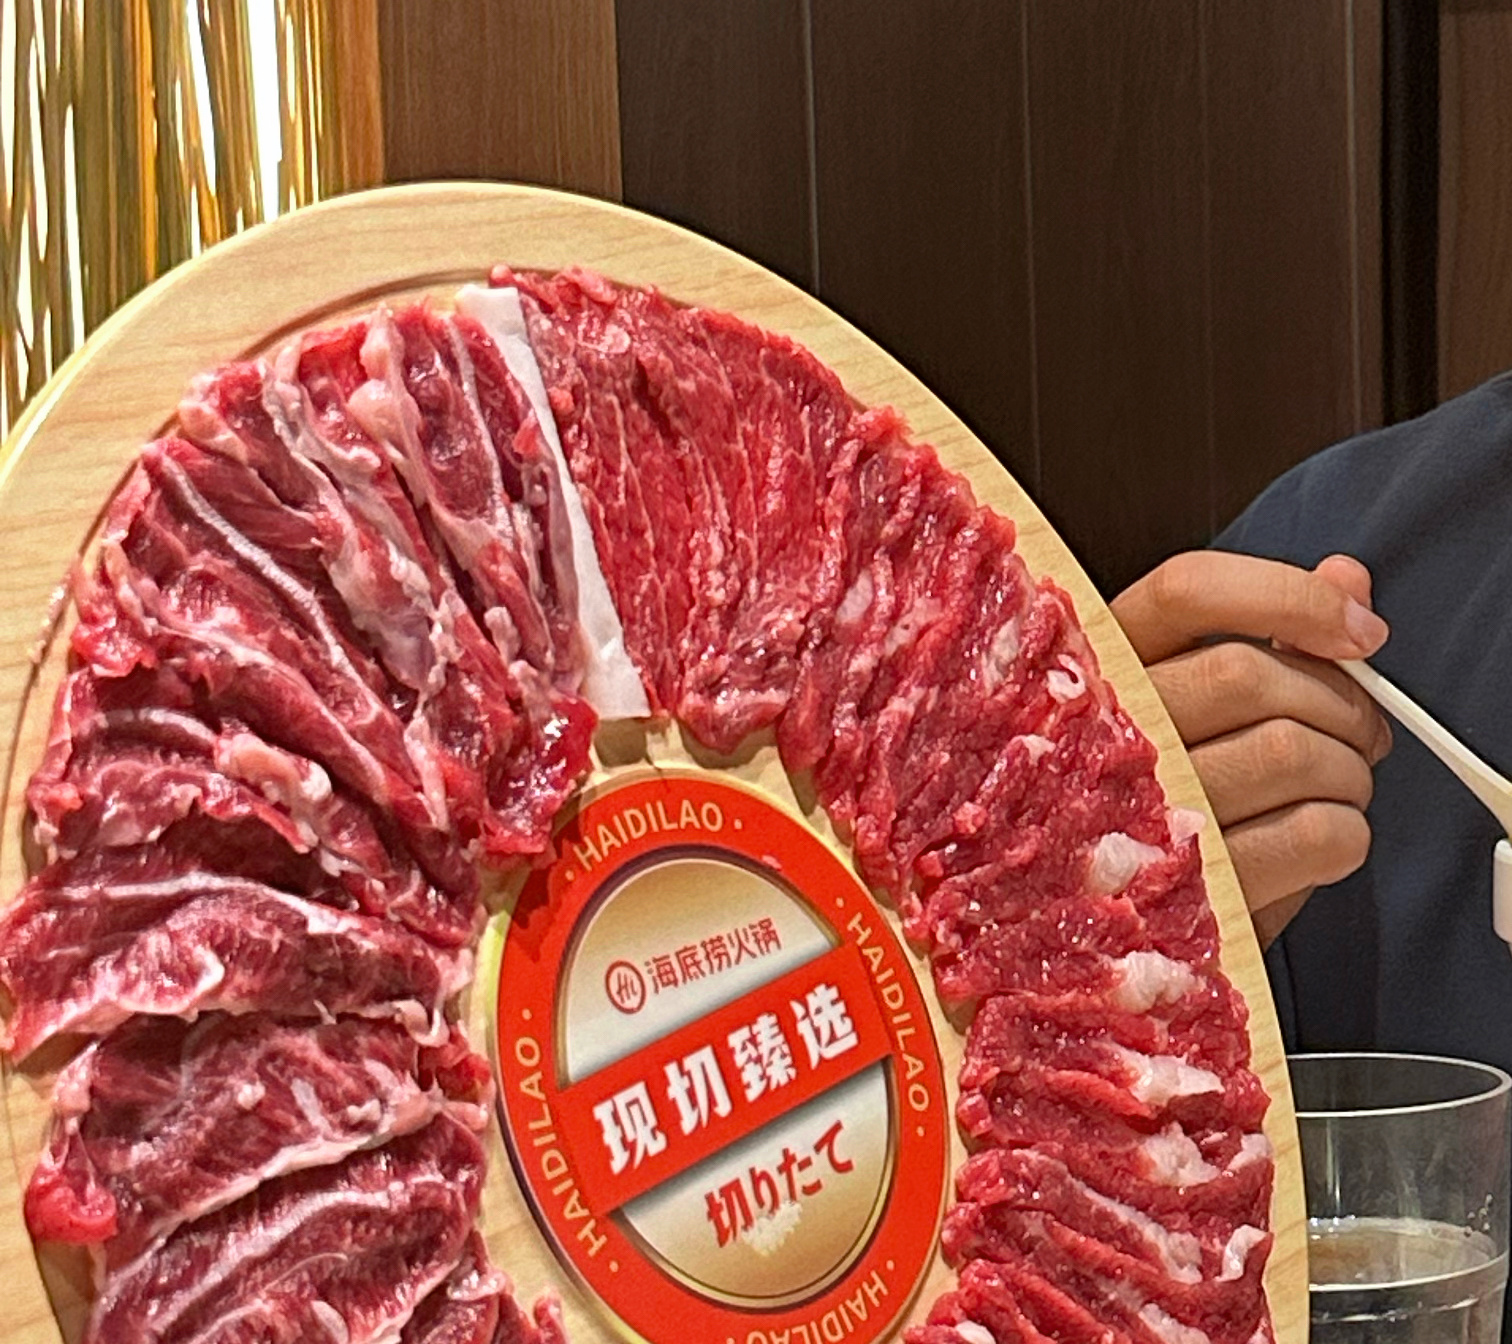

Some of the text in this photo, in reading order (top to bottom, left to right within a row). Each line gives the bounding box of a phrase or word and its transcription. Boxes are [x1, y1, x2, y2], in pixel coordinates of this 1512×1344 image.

[573, 799, 724, 872] HAIDILAO
[644, 917, 782, 995] 海底捞火锅
[847, 912, 930, 1112] HAIDILAO
[515, 1036, 608, 1257] HAIDILAO
[593, 983, 859, 1175] 现切臻选
[704, 1120, 854, 1248] 切りたて
